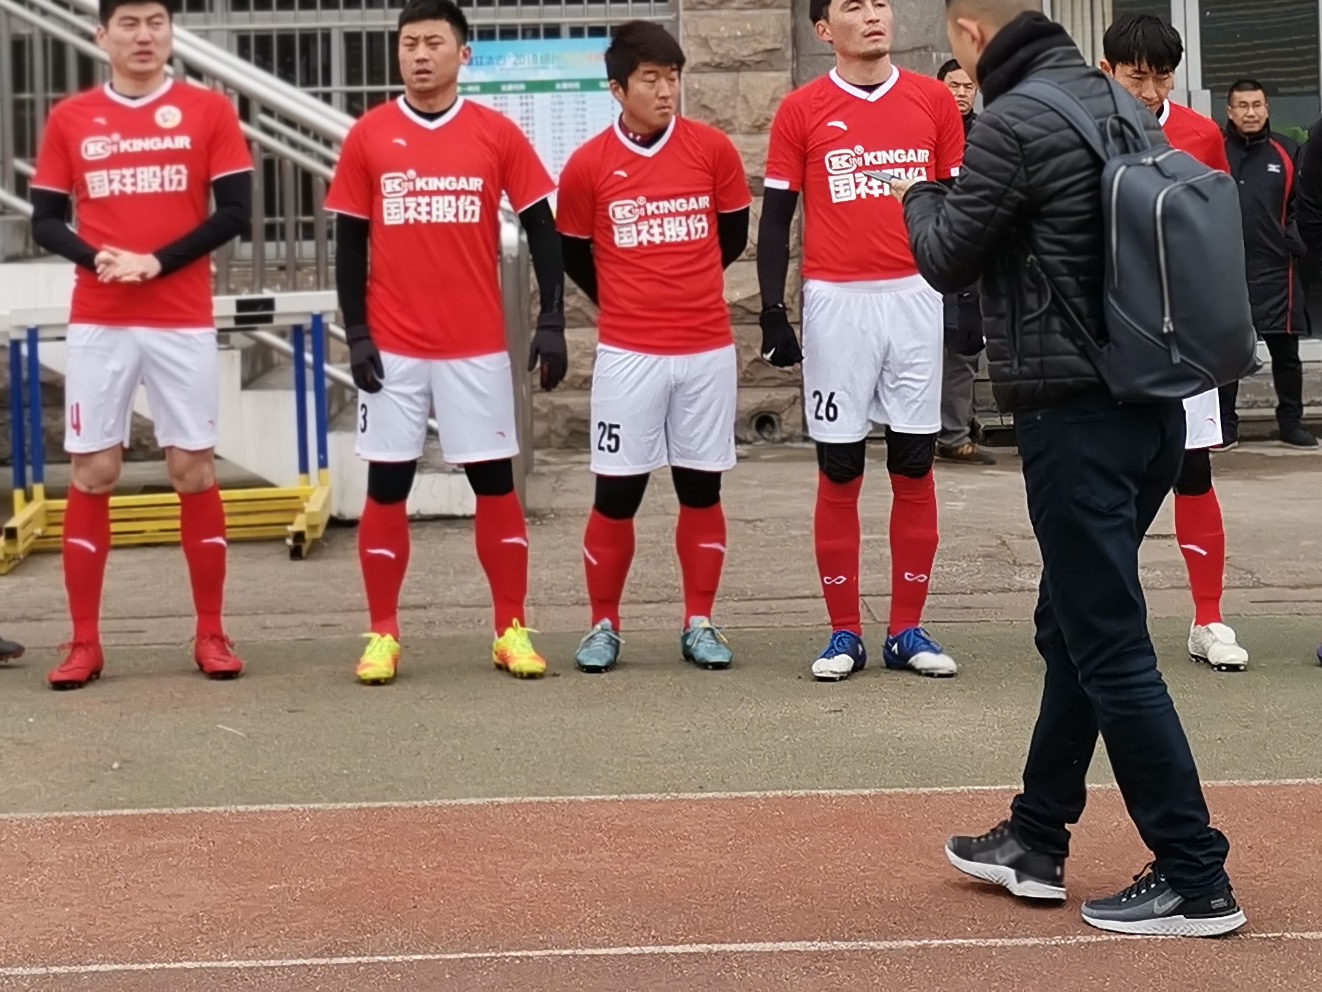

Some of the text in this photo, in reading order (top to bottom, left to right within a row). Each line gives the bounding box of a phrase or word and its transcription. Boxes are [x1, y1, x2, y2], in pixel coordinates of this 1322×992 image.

[119, 135, 192, 153] KINGAIR
[863, 148, 930, 166] KINGAIR
[84, 164, 188, 199] 国祥股份
[414, 175, 484, 192] KINGAIR
[828, 166, 928, 204] 国祥
[382, 195, 482, 226] 国祥股份
[645, 195, 710, 217] KINGAIR
[612, 213, 709, 248] 国祥股份
[70, 402, 82, 437] 4
[359, 403, 369, 434] 3
[812, 389, 839, 423] 26
[597, 420, 621, 454] 25
